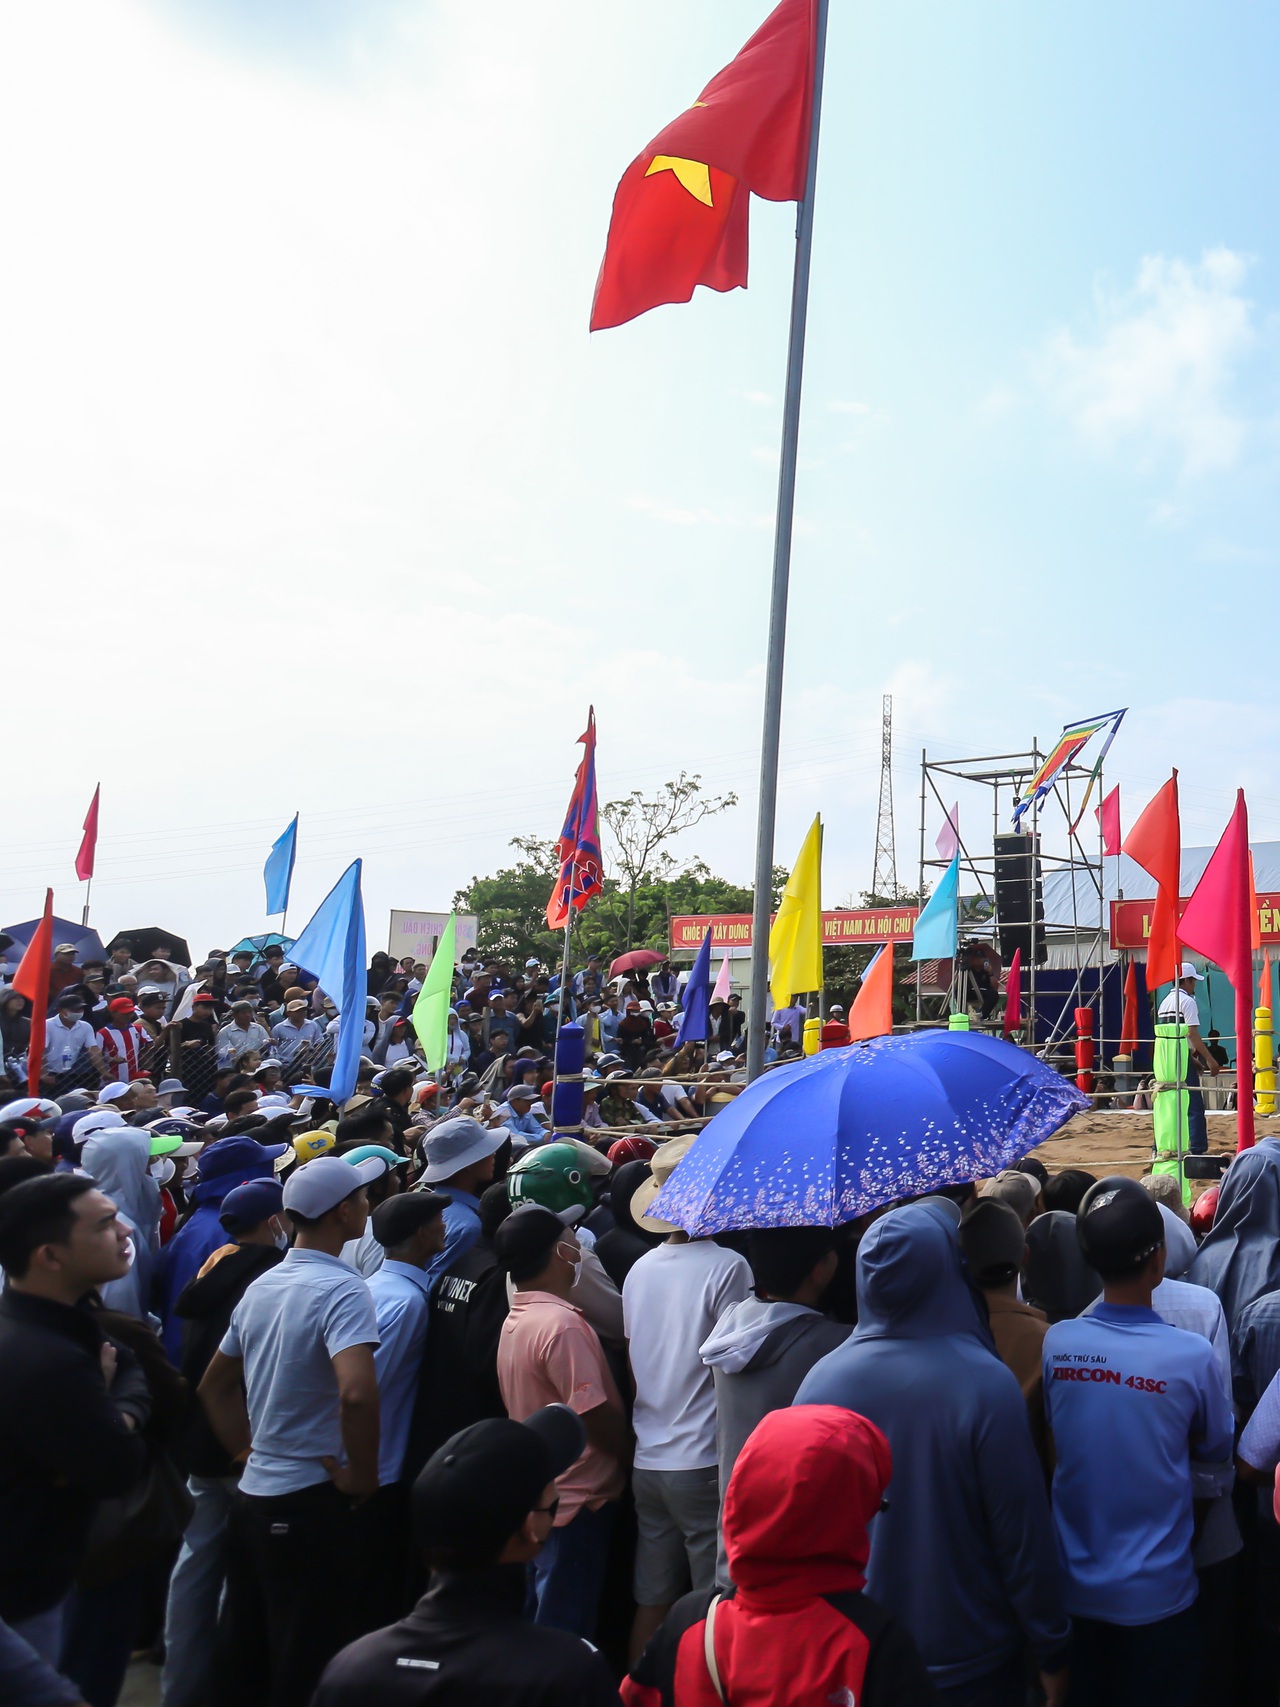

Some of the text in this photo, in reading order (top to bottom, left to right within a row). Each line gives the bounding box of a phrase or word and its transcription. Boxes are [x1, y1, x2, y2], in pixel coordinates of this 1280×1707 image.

[682, 921, 700, 941] KHỎE
[713, 922, 727, 940] XÂY
[729, 922, 749, 943] DỰNG
[825, 912, 911, 939] VIỆT NAM XÃ HỘI CHỦ
[307, 1138, 327, 1150] be
[1124, 1375, 1167, 1395] 43SC
